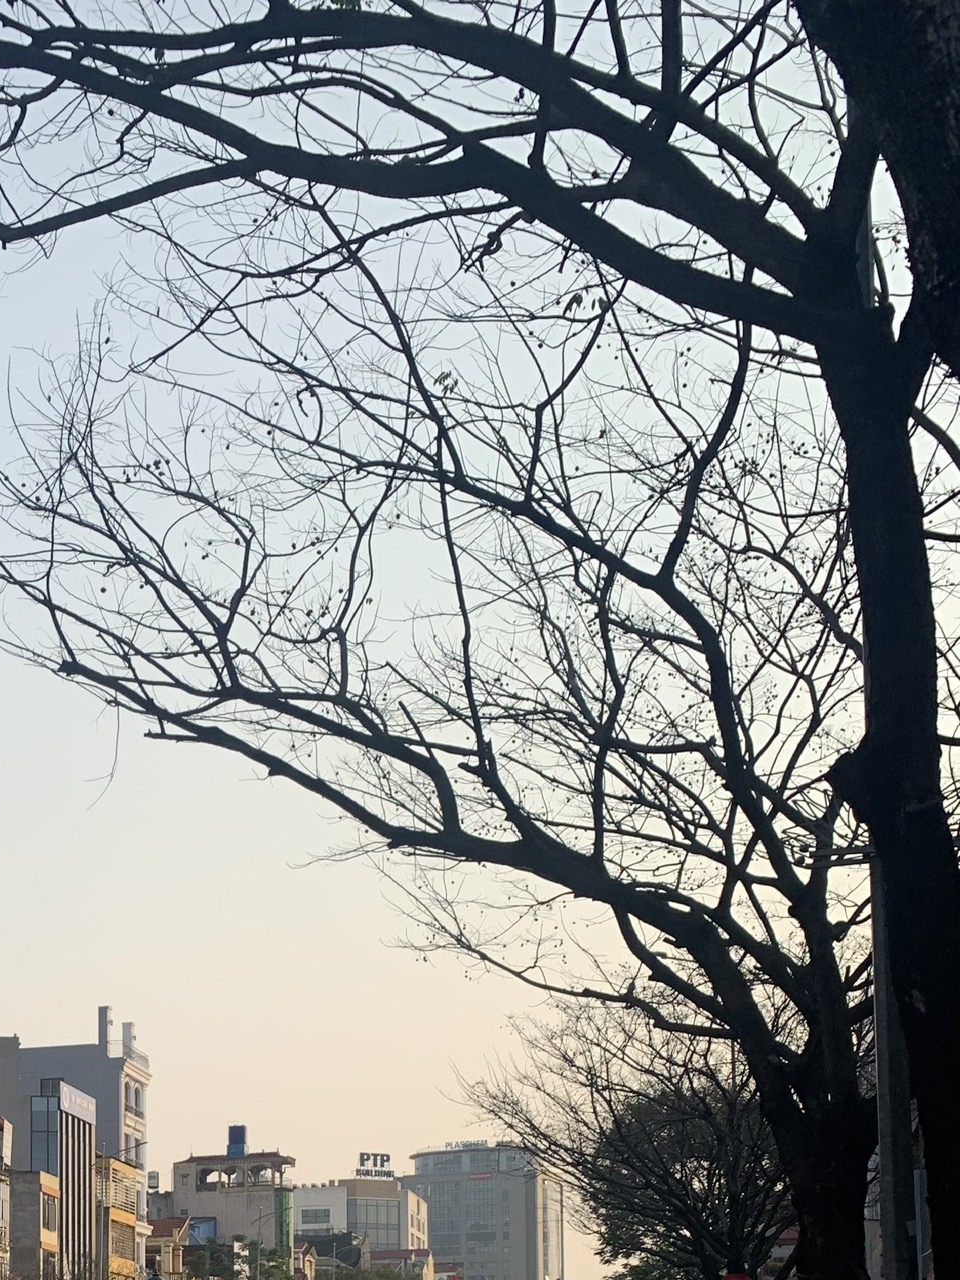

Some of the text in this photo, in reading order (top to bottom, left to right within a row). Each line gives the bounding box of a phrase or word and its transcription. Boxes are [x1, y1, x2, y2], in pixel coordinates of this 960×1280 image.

[445, 1140, 488, 1149] PLASCHEM
[359, 1152, 391, 1168] PTP
[356, 1169, 394, 1178] BUILDING
